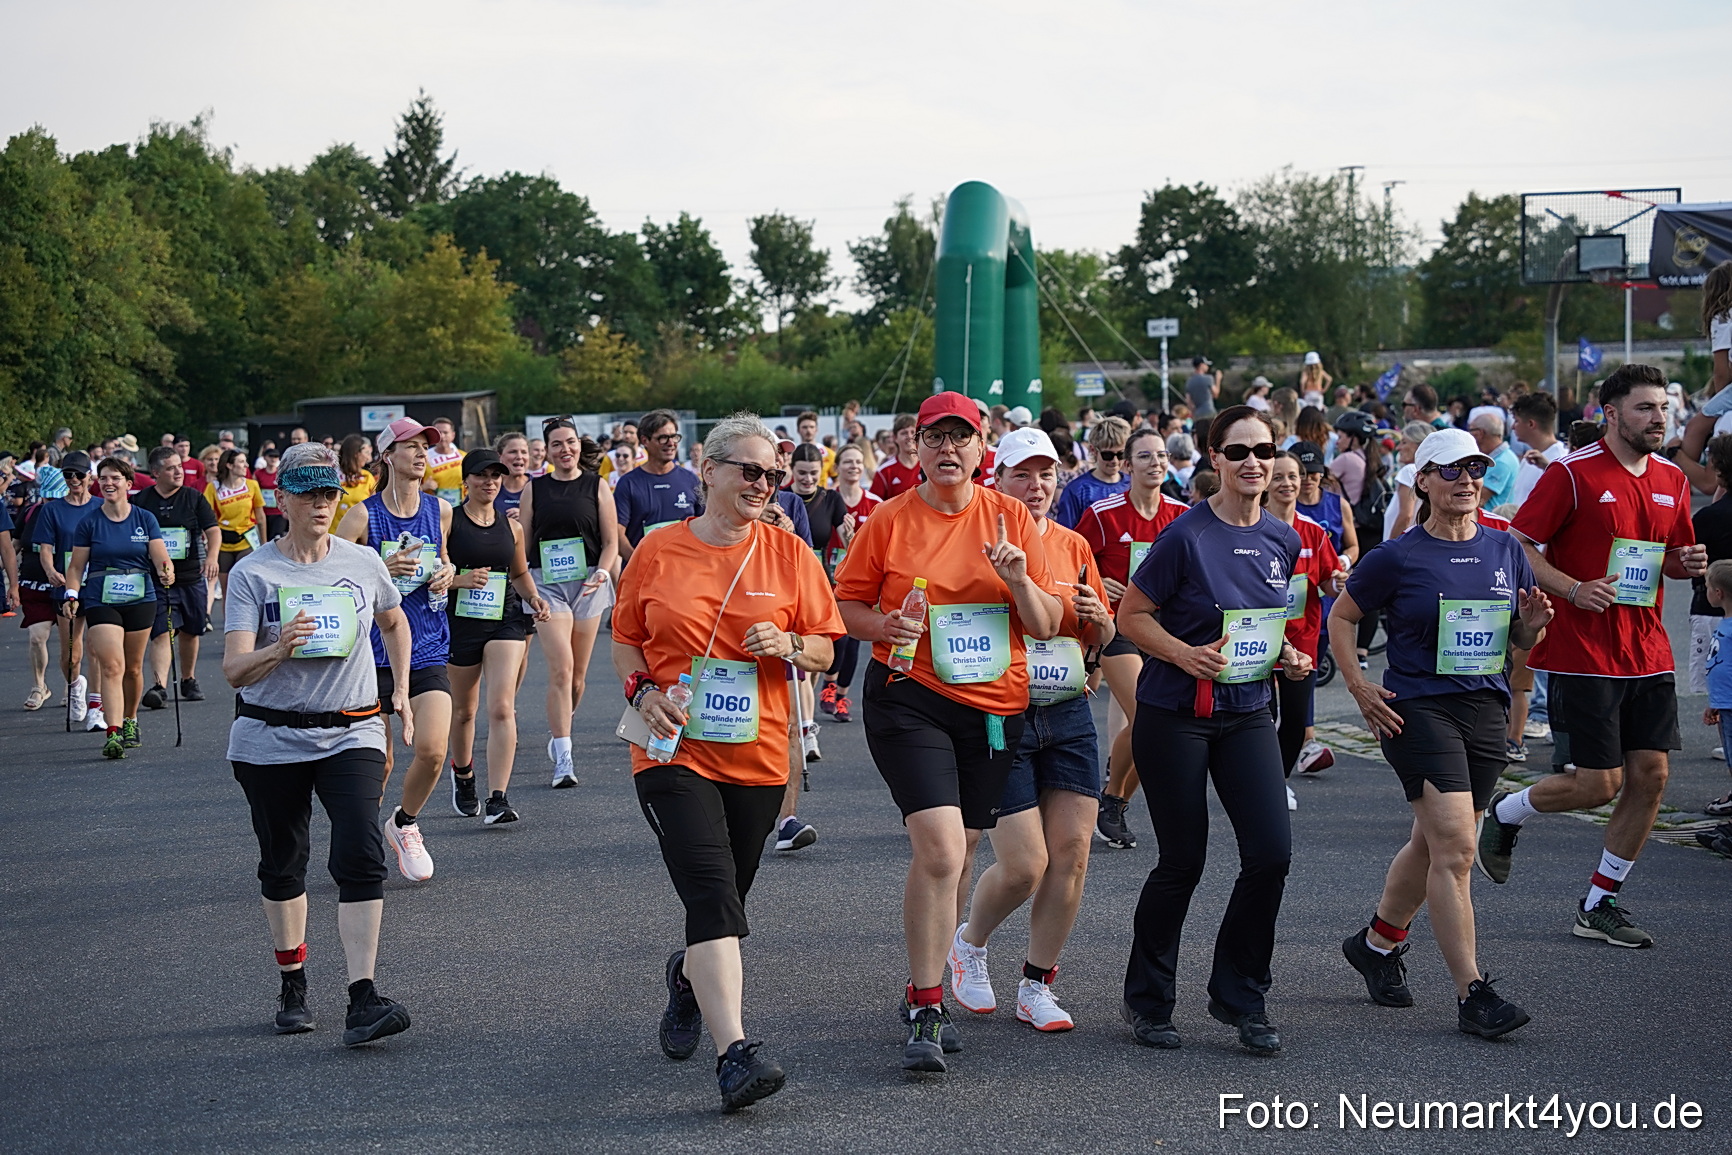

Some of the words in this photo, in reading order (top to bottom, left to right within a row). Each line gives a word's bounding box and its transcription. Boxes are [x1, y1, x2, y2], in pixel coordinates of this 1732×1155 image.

[550, 556, 575, 567] 1568
[1625, 566, 1648, 582] 1110
[112, 582, 134, 592] 2212
[469, 590, 494, 602] 1573
[312, 615, 340, 630] 515
[947, 636, 991, 654] 1048
[1455, 632, 1494, 646] 1567
[1234, 640, 1268, 657] 1564
[952, 656, 976, 664] Christa
[1032, 665, 1069, 682] 1047
[705, 692, 751, 712] 1060
[700, 712, 734, 722] Sieglinde
